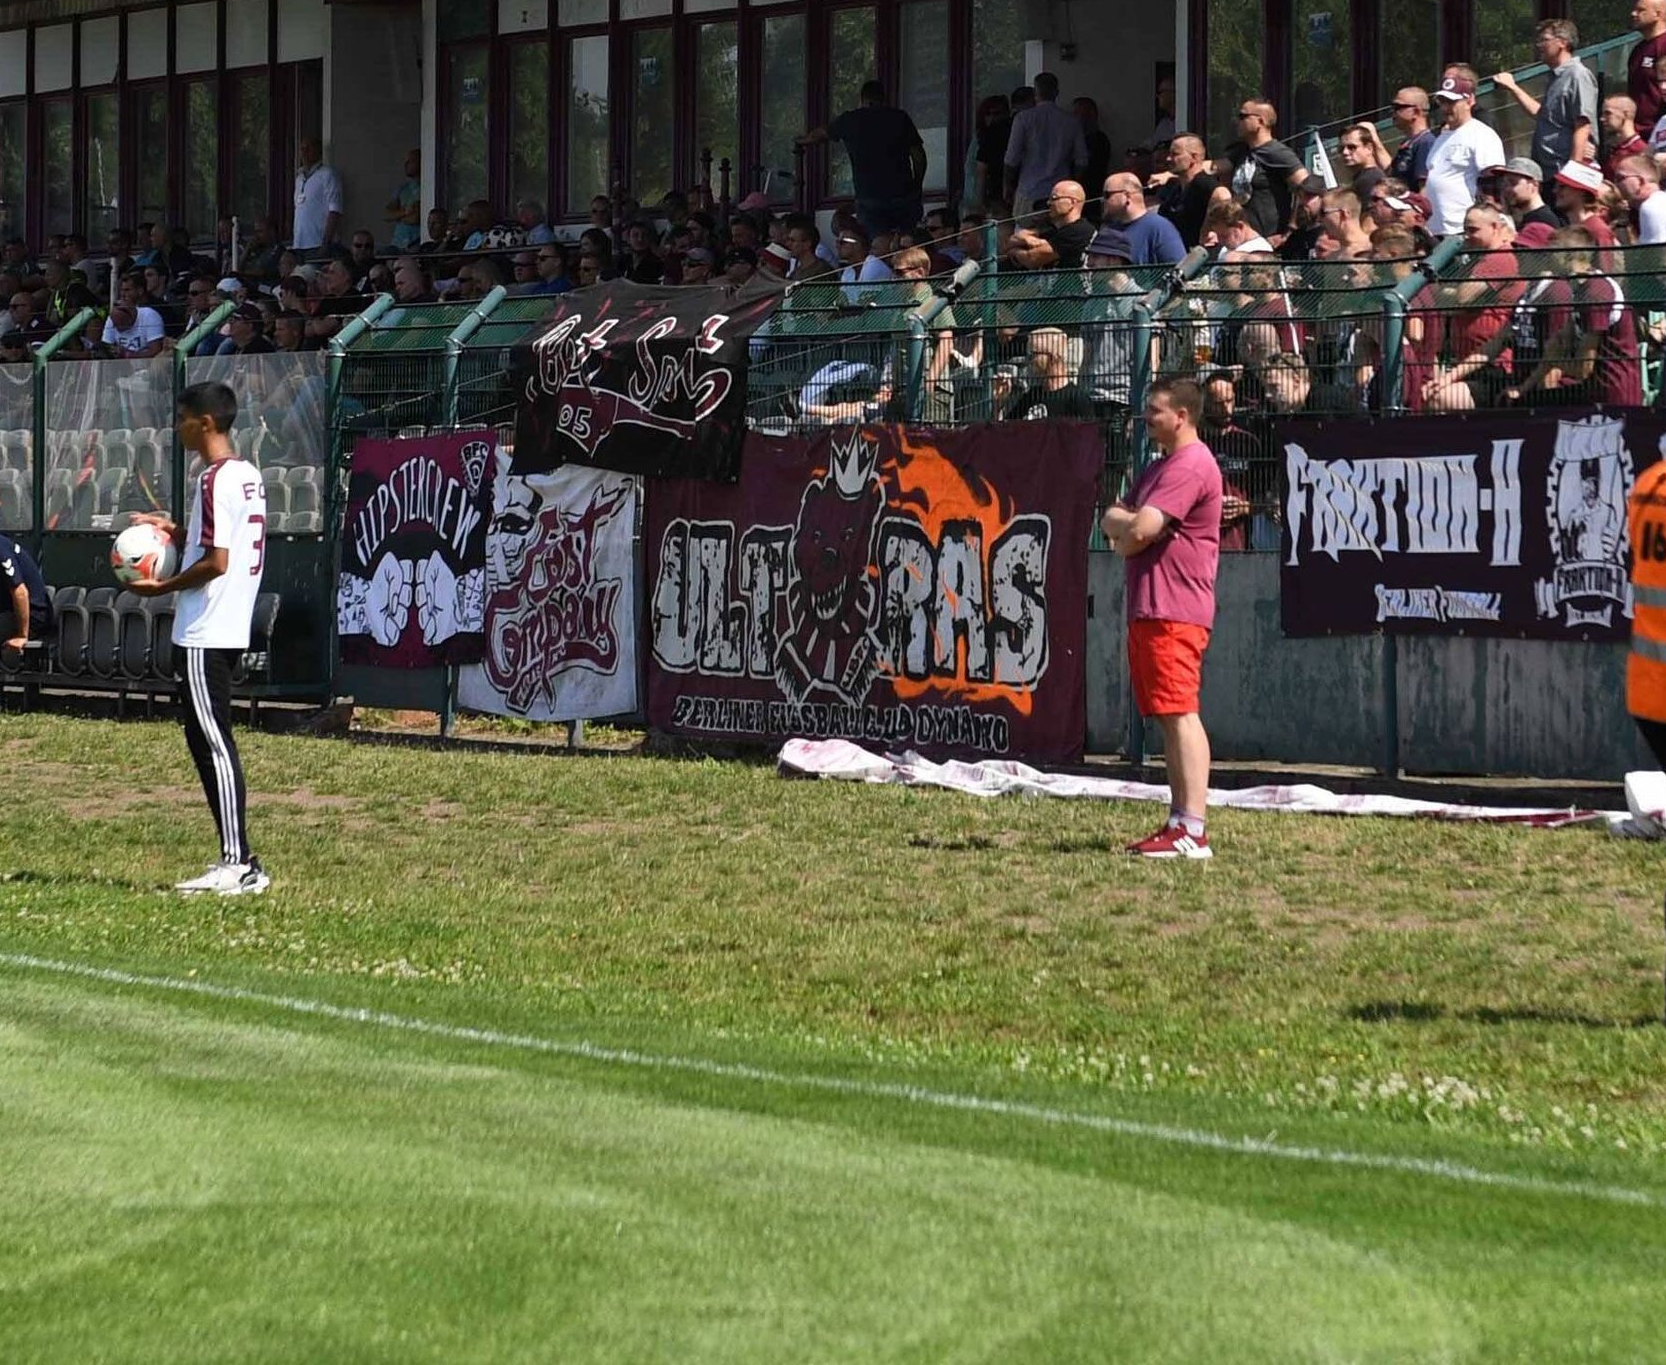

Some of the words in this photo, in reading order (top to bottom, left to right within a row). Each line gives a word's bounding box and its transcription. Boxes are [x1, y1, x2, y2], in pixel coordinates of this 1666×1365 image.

[559, 404, 592, 439] 05
[462, 442, 489, 463] BFC
[353, 456, 482, 567] HIPSTERCREW
[671, 695, 764, 734] BERLINER
[915, 704, 1010, 754] DYNAMO
